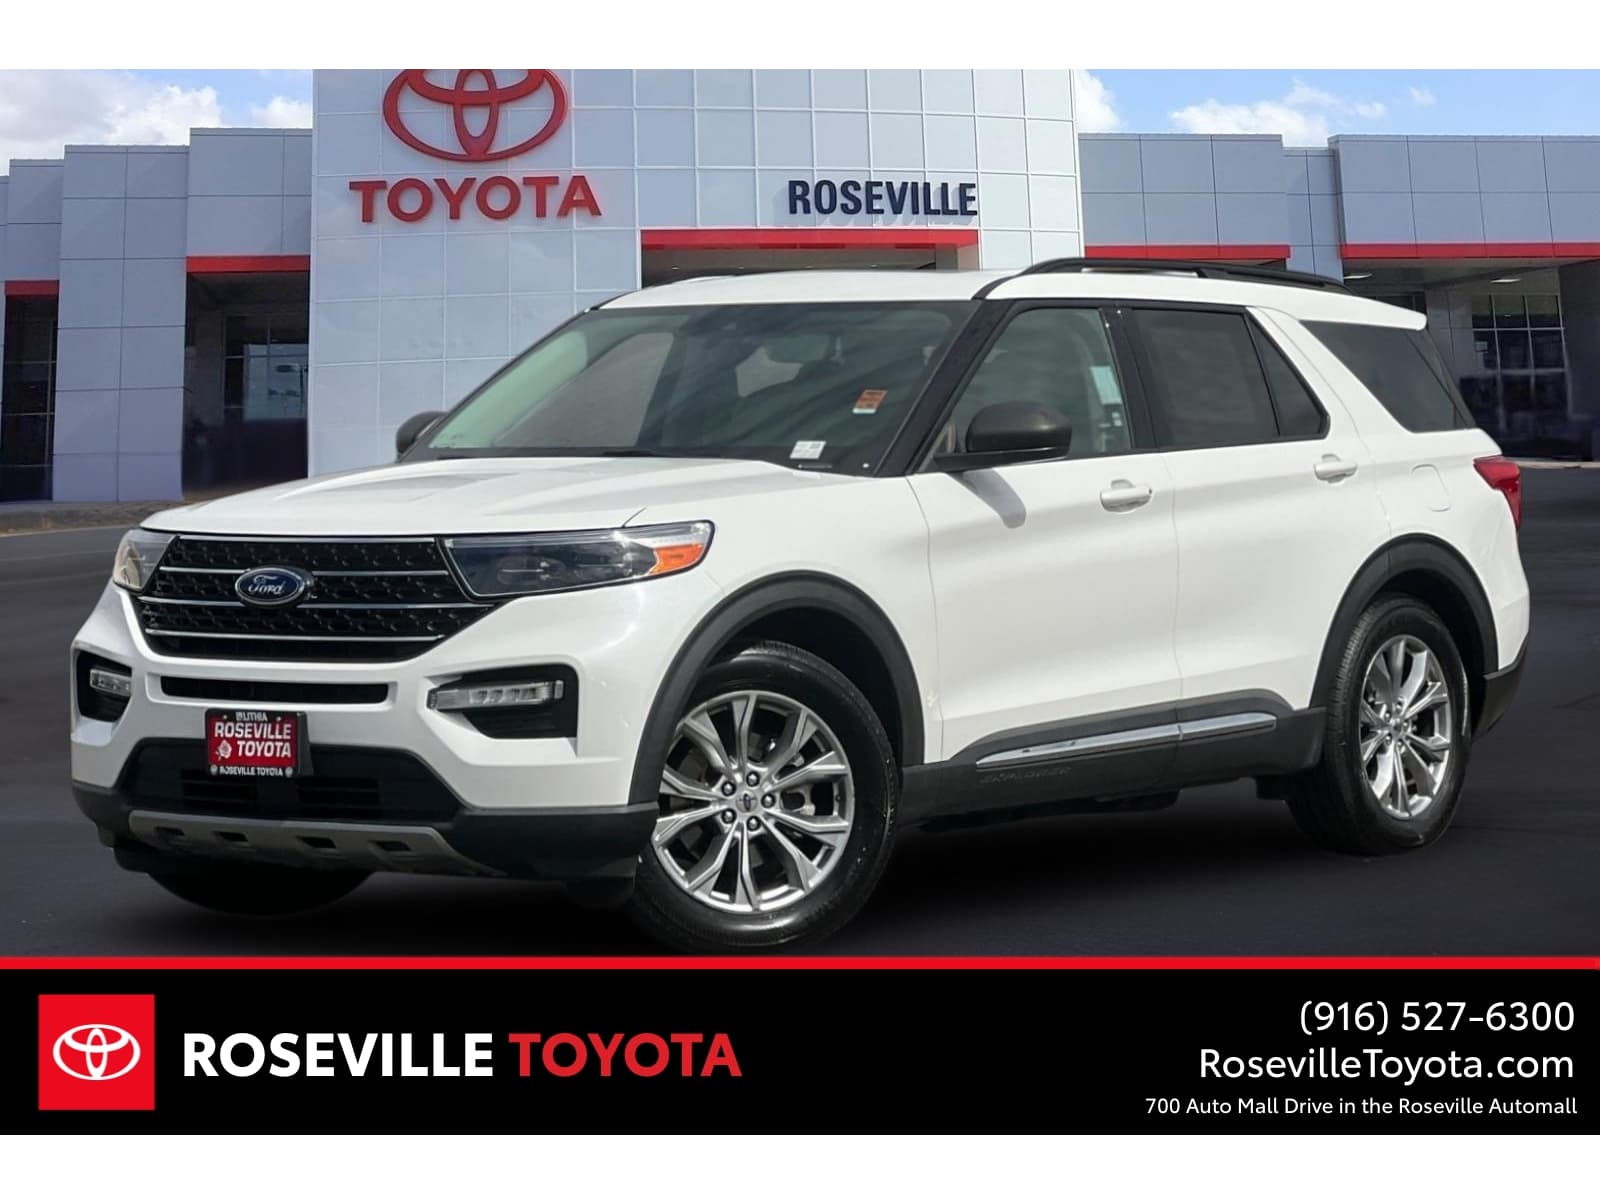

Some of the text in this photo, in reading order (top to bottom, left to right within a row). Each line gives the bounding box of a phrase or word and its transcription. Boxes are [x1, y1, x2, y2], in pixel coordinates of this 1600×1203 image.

[349, 174, 602, 224] TOYOTA
[788, 179, 978, 217] ROSEVILLE
[247, 574, 286, 595] Ford
[214, 722, 292, 739] ROSEVILLE
[236, 741, 292, 758] TOYOTA
[220, 766, 283, 777] ROSEVILLE TOYOTA
